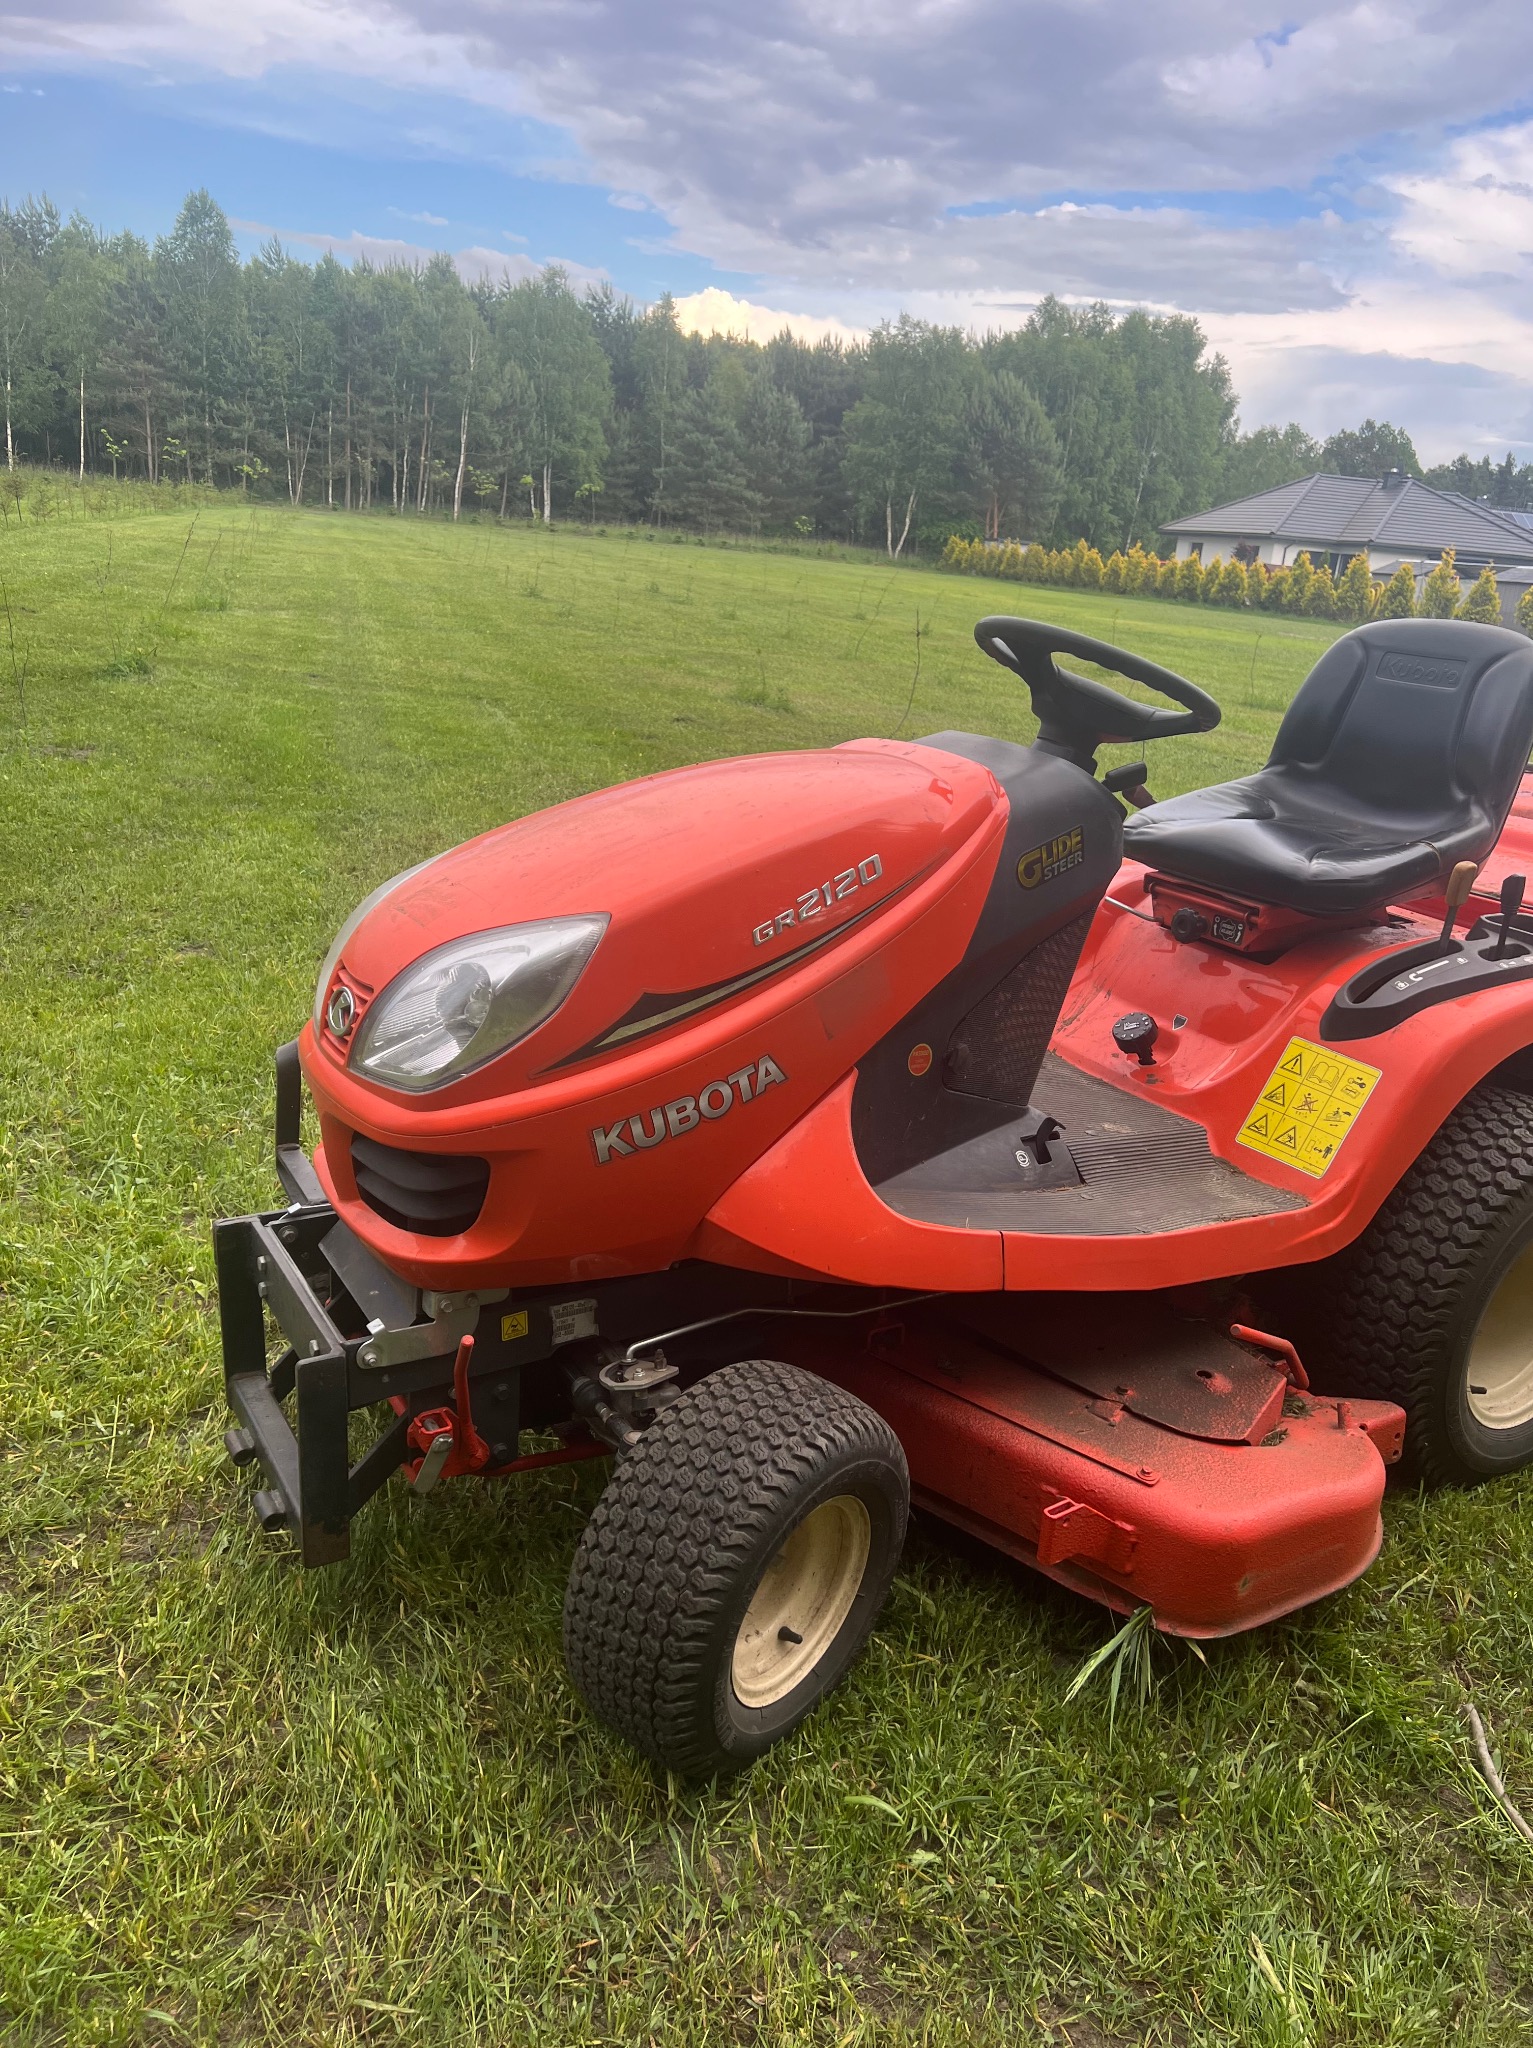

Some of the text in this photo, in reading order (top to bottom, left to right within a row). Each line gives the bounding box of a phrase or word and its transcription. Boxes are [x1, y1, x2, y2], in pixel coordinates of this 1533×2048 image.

[1383, 655, 1460, 685] Kubota
[1018, 827, 1083, 888] GLIDE
[1044, 851, 1083, 881] STEER
[752, 853, 883, 946] GR2120
[592, 1054, 788, 1165] KUBOTA
